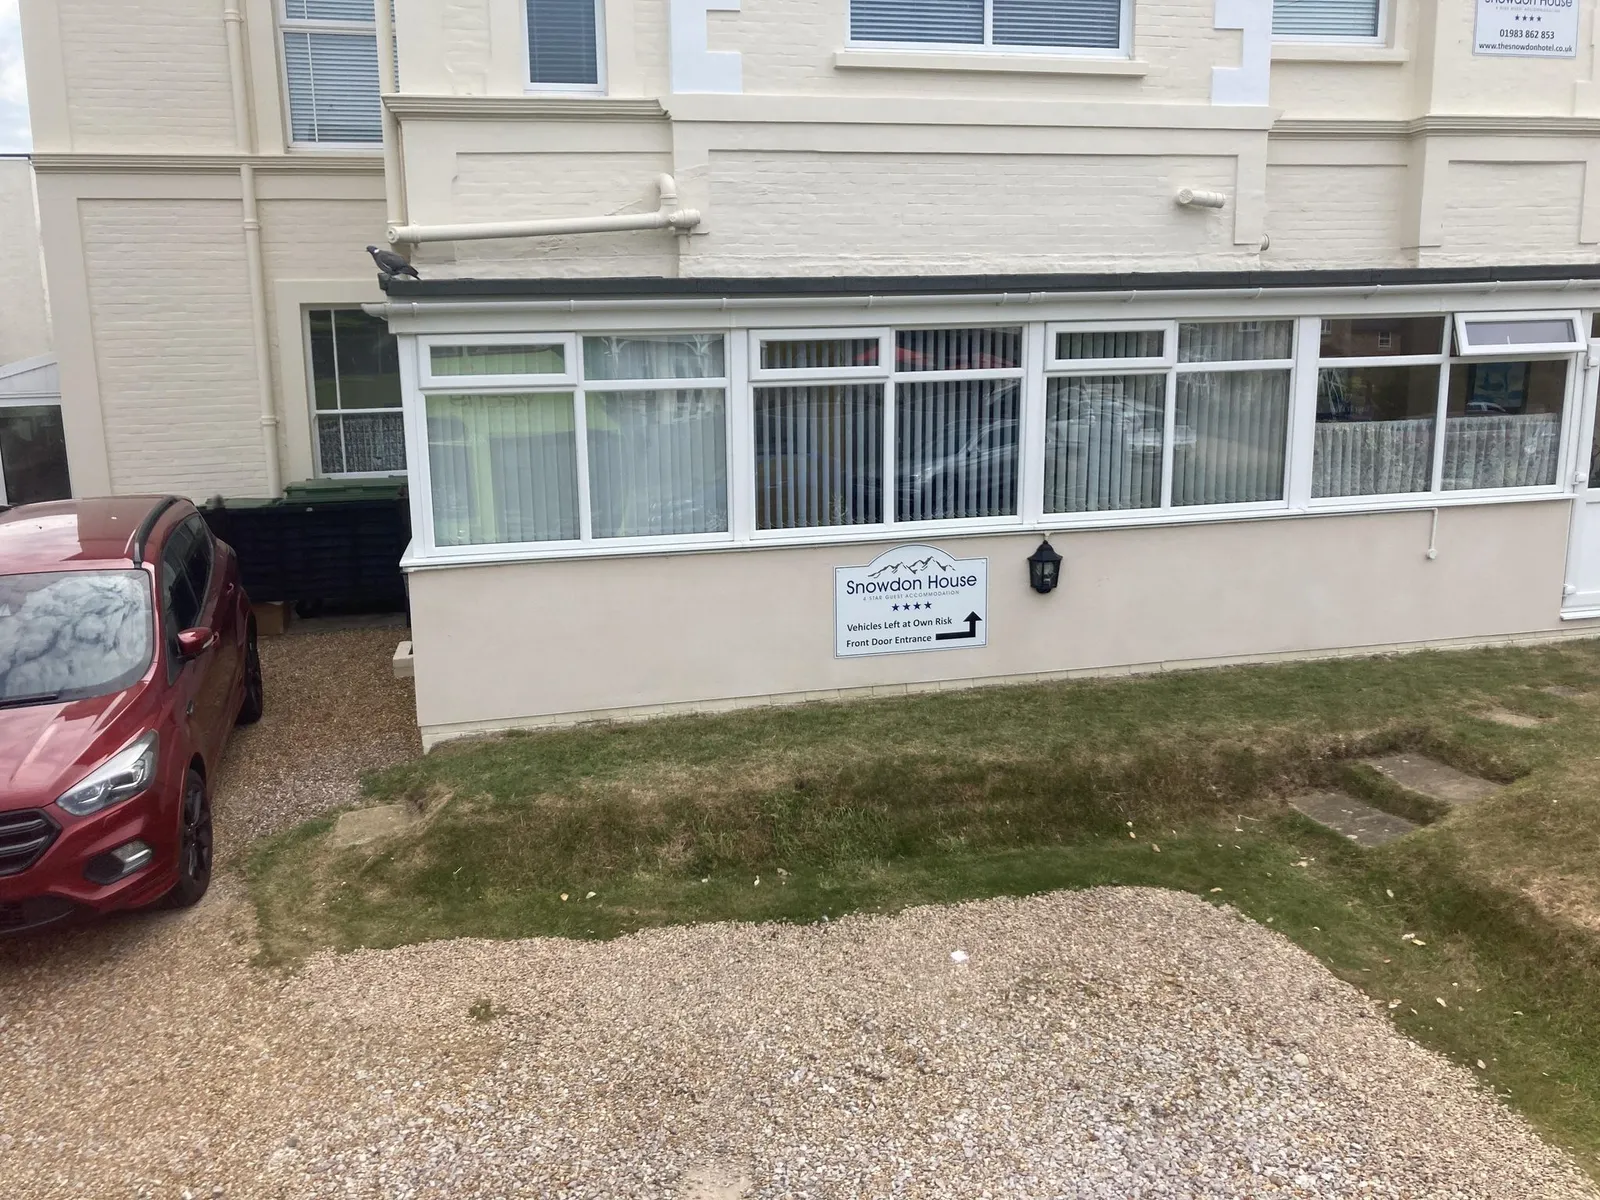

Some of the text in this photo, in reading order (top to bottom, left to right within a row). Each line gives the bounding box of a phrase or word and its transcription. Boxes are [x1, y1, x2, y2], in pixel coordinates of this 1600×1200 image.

[1499, 29, 1555, 40] 01983 862 853
[1479, 42, 1573, 52] www.thesnowdonhotel.co.uk
[846, 574, 977, 595] Snowdon House
[905, 590, 960, 598] ACCOMMODATION
[847, 616, 953, 632] Vehicles Left at Own Risk
[846, 635, 932, 648] Front Door Entrance
